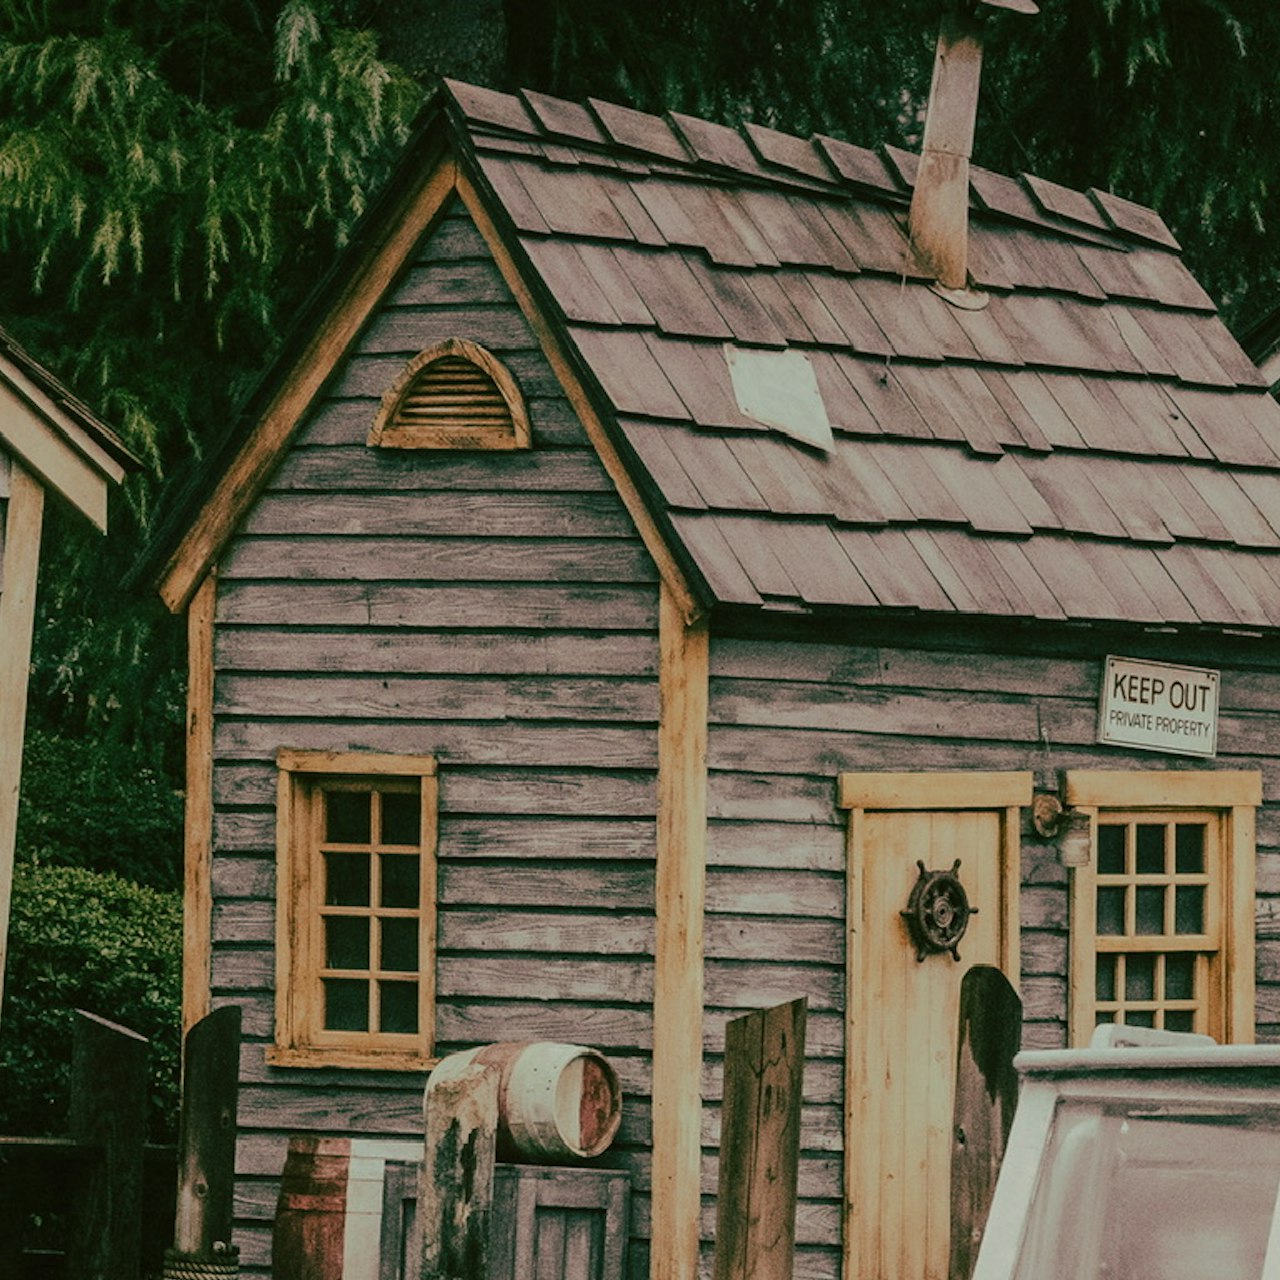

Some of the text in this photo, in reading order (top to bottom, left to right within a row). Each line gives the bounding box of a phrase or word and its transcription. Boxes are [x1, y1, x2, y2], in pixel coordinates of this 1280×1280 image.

[1113, 673, 1210, 712] KEEP OUT
[1110, 710, 1211, 738] PRIVATE PROPERTY
